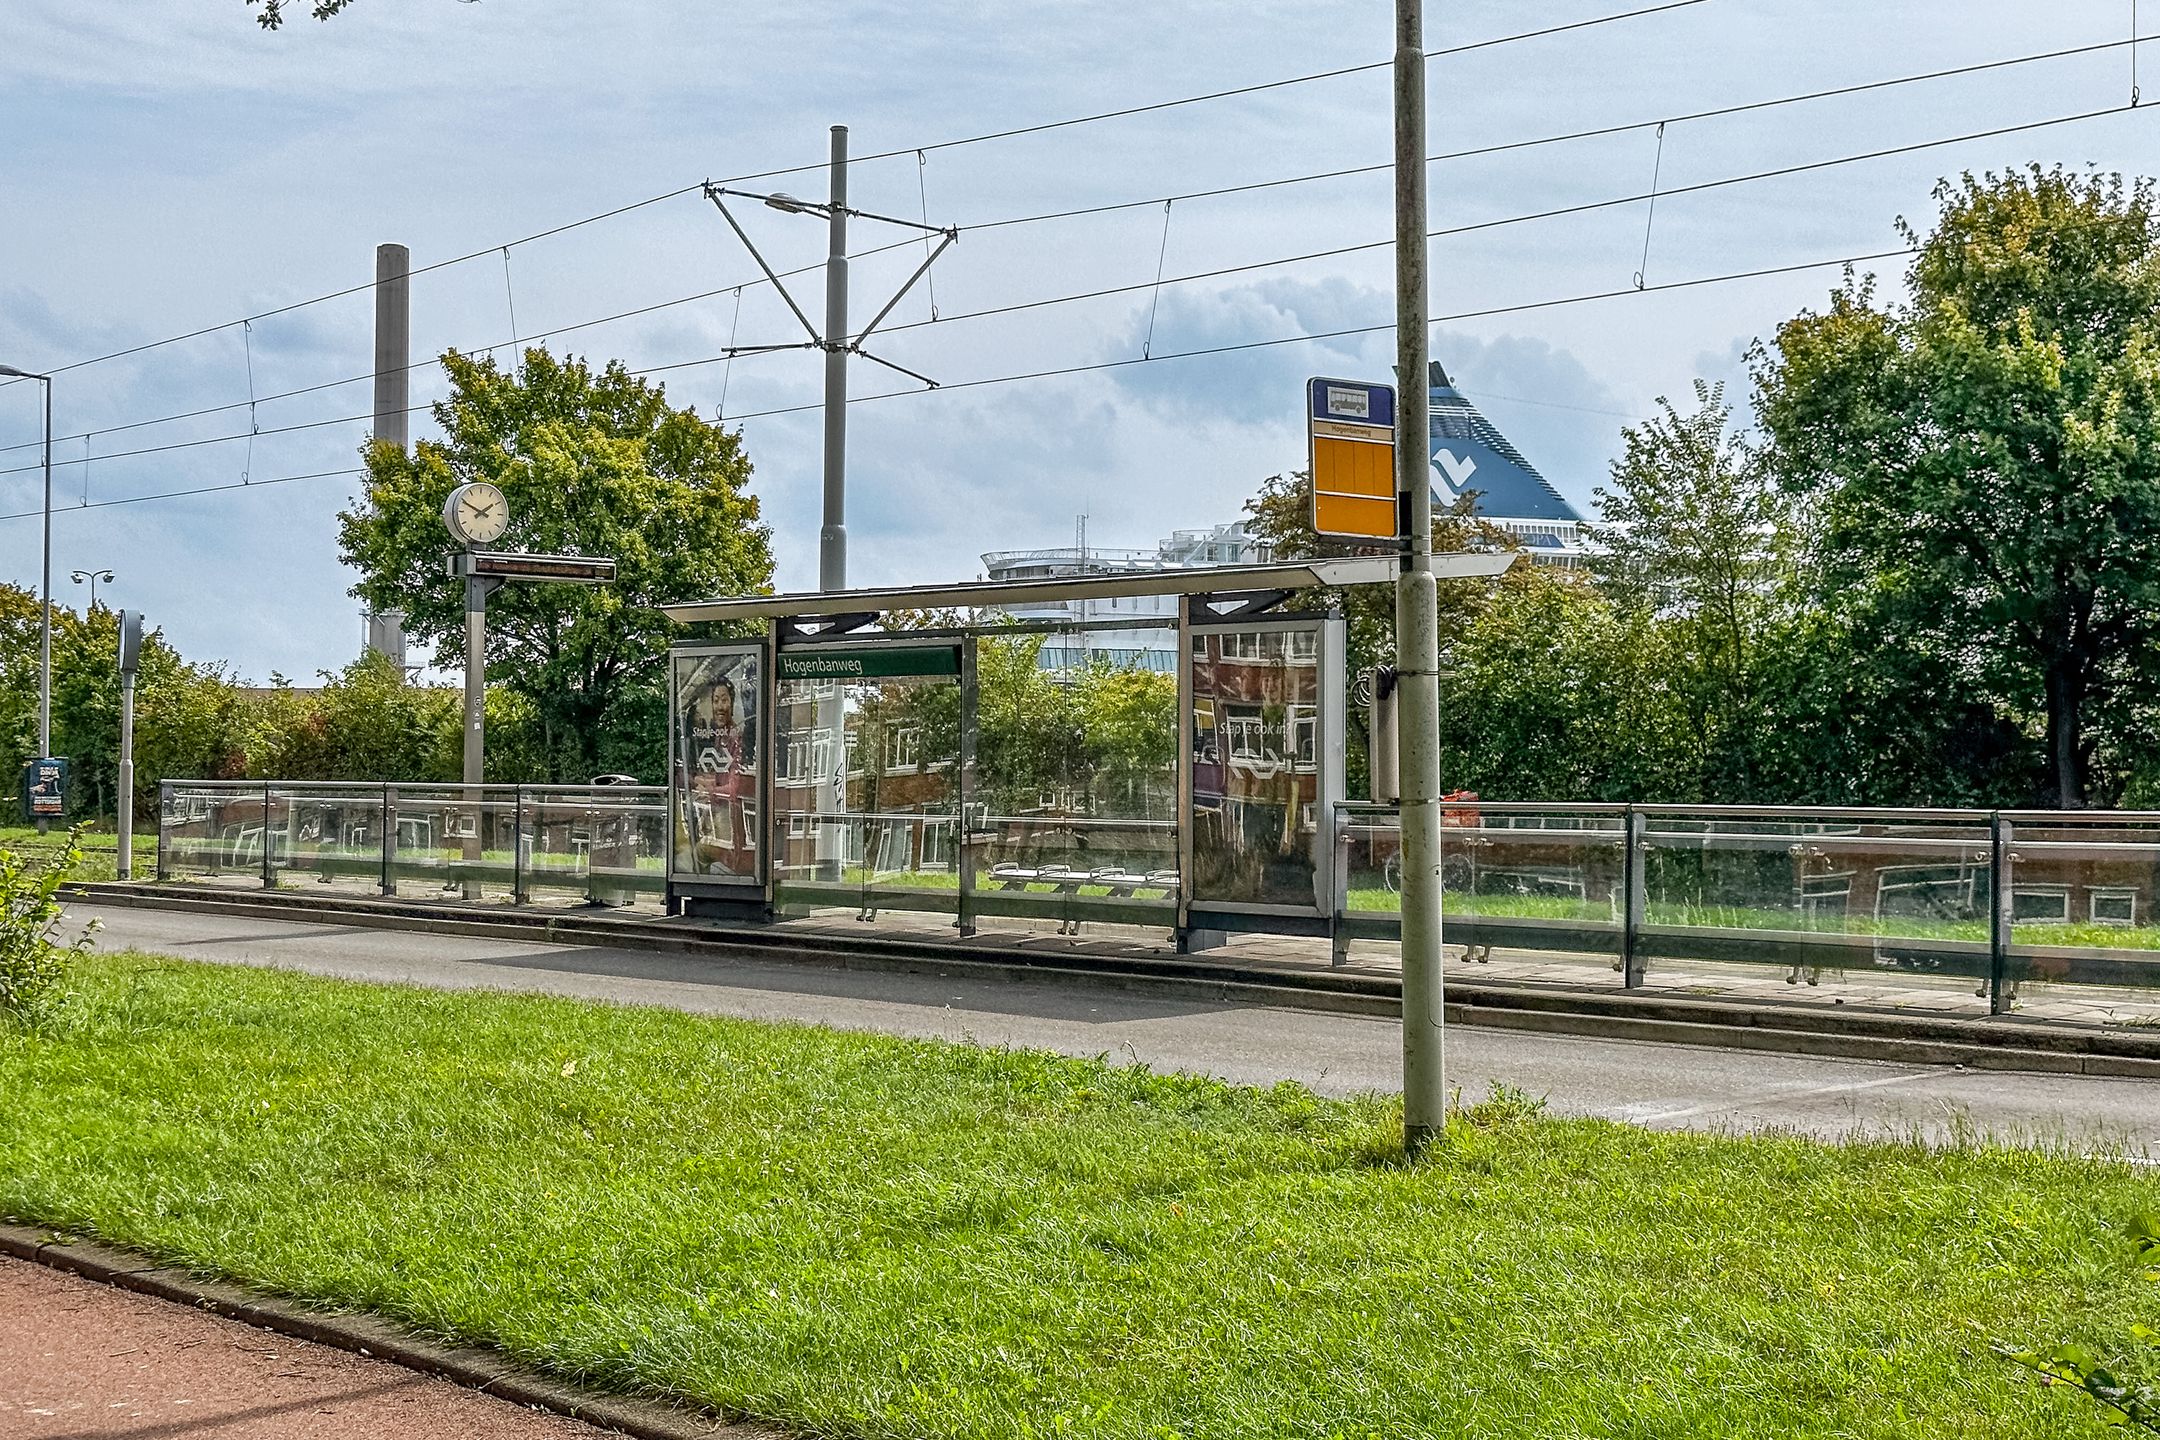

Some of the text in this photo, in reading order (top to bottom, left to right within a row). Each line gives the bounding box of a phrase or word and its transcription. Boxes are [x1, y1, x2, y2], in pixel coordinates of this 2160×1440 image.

[783, 656, 863, 677] Hogenbanweg
[1219, 722, 1241, 738] Stap
[1254, 721, 1275, 735] ook
